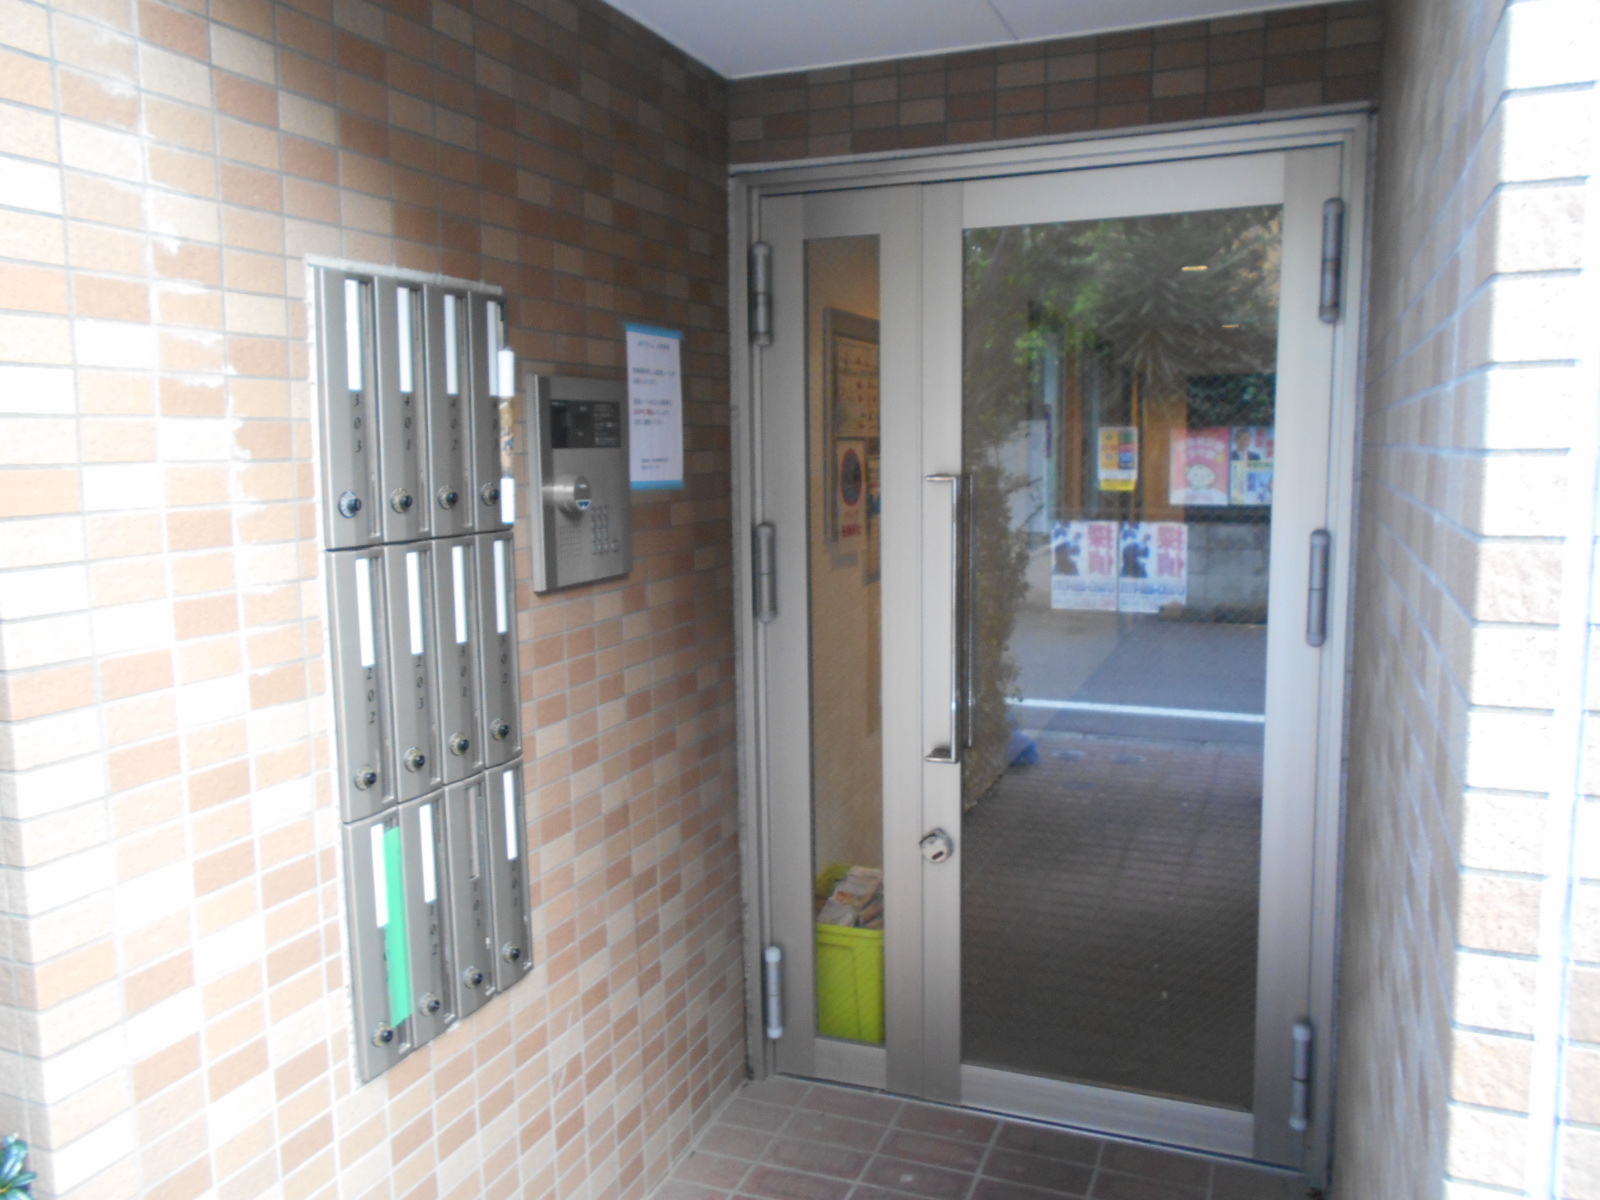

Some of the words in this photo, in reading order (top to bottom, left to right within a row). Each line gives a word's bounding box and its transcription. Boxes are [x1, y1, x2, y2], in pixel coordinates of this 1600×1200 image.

[353, 394, 362, 453] 303
[404, 396, 412, 451] 401
[366, 667, 376, 725] 202
[416, 655, 425, 710] 203
